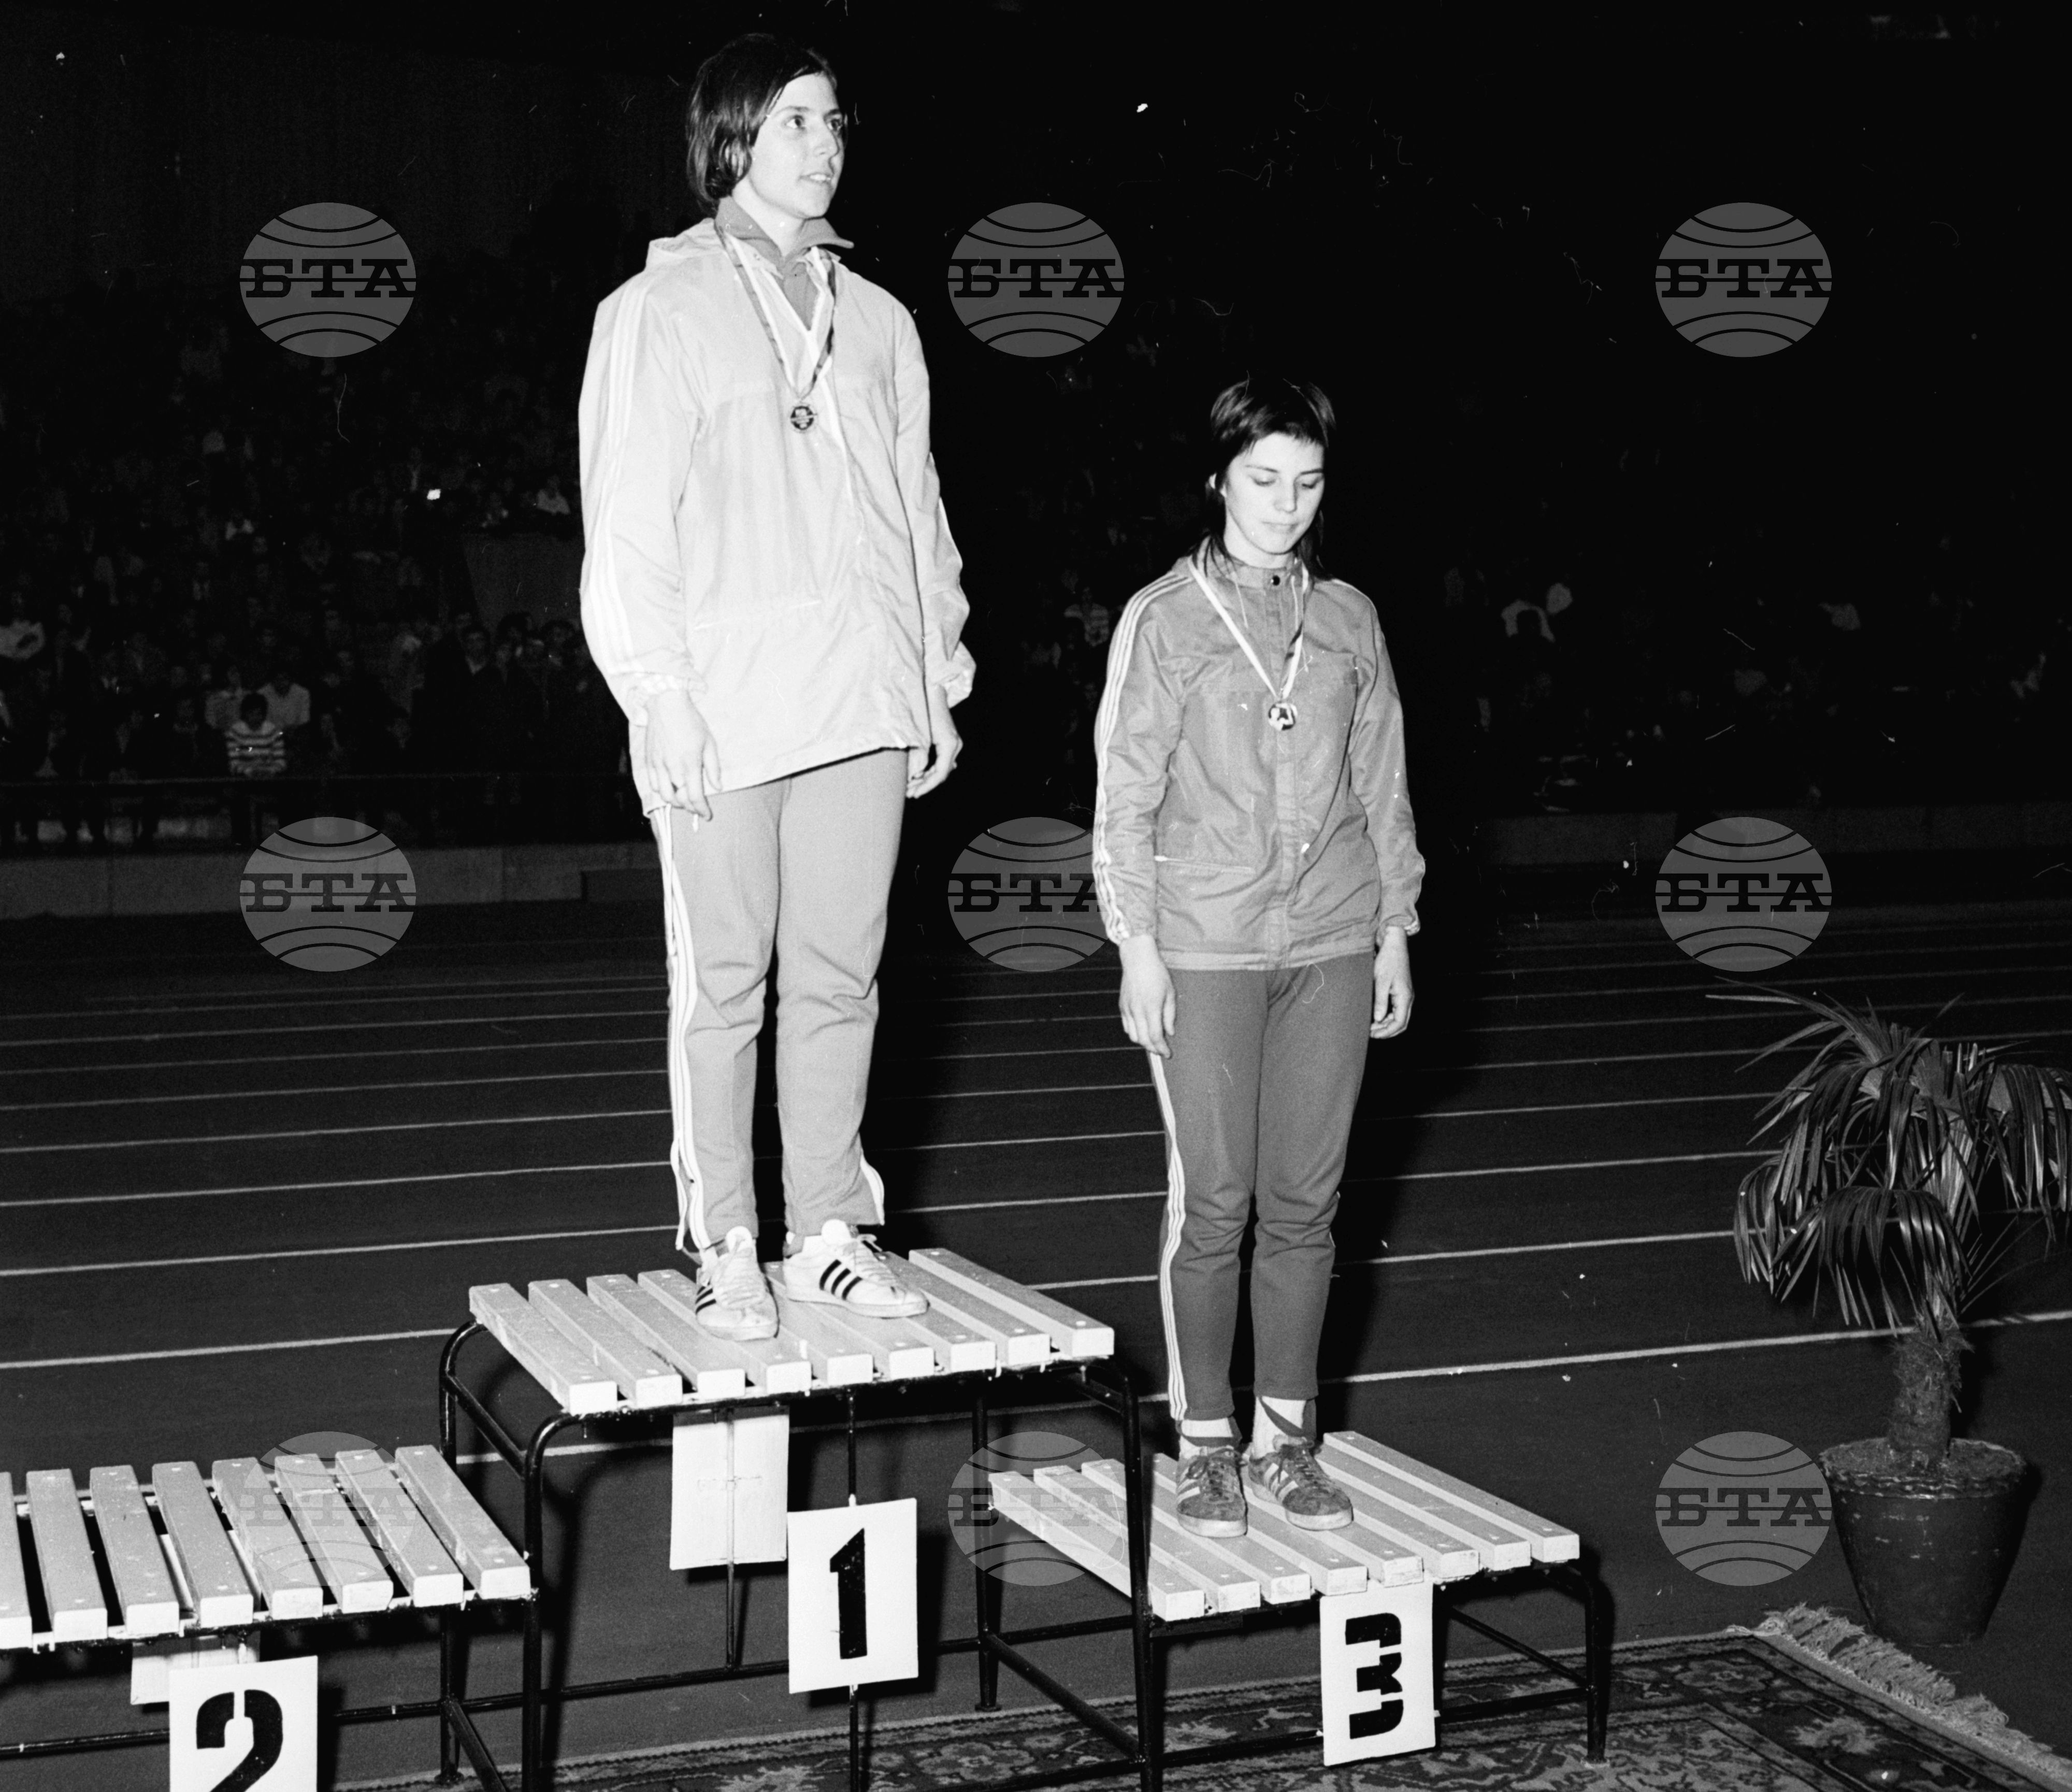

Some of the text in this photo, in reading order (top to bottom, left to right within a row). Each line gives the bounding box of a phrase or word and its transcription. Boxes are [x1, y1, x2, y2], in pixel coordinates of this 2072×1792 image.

[830, 1528, 867, 1659] 1
[1345, 1613, 1404, 1739] 3
[196, 1689, 283, 1792] 2
